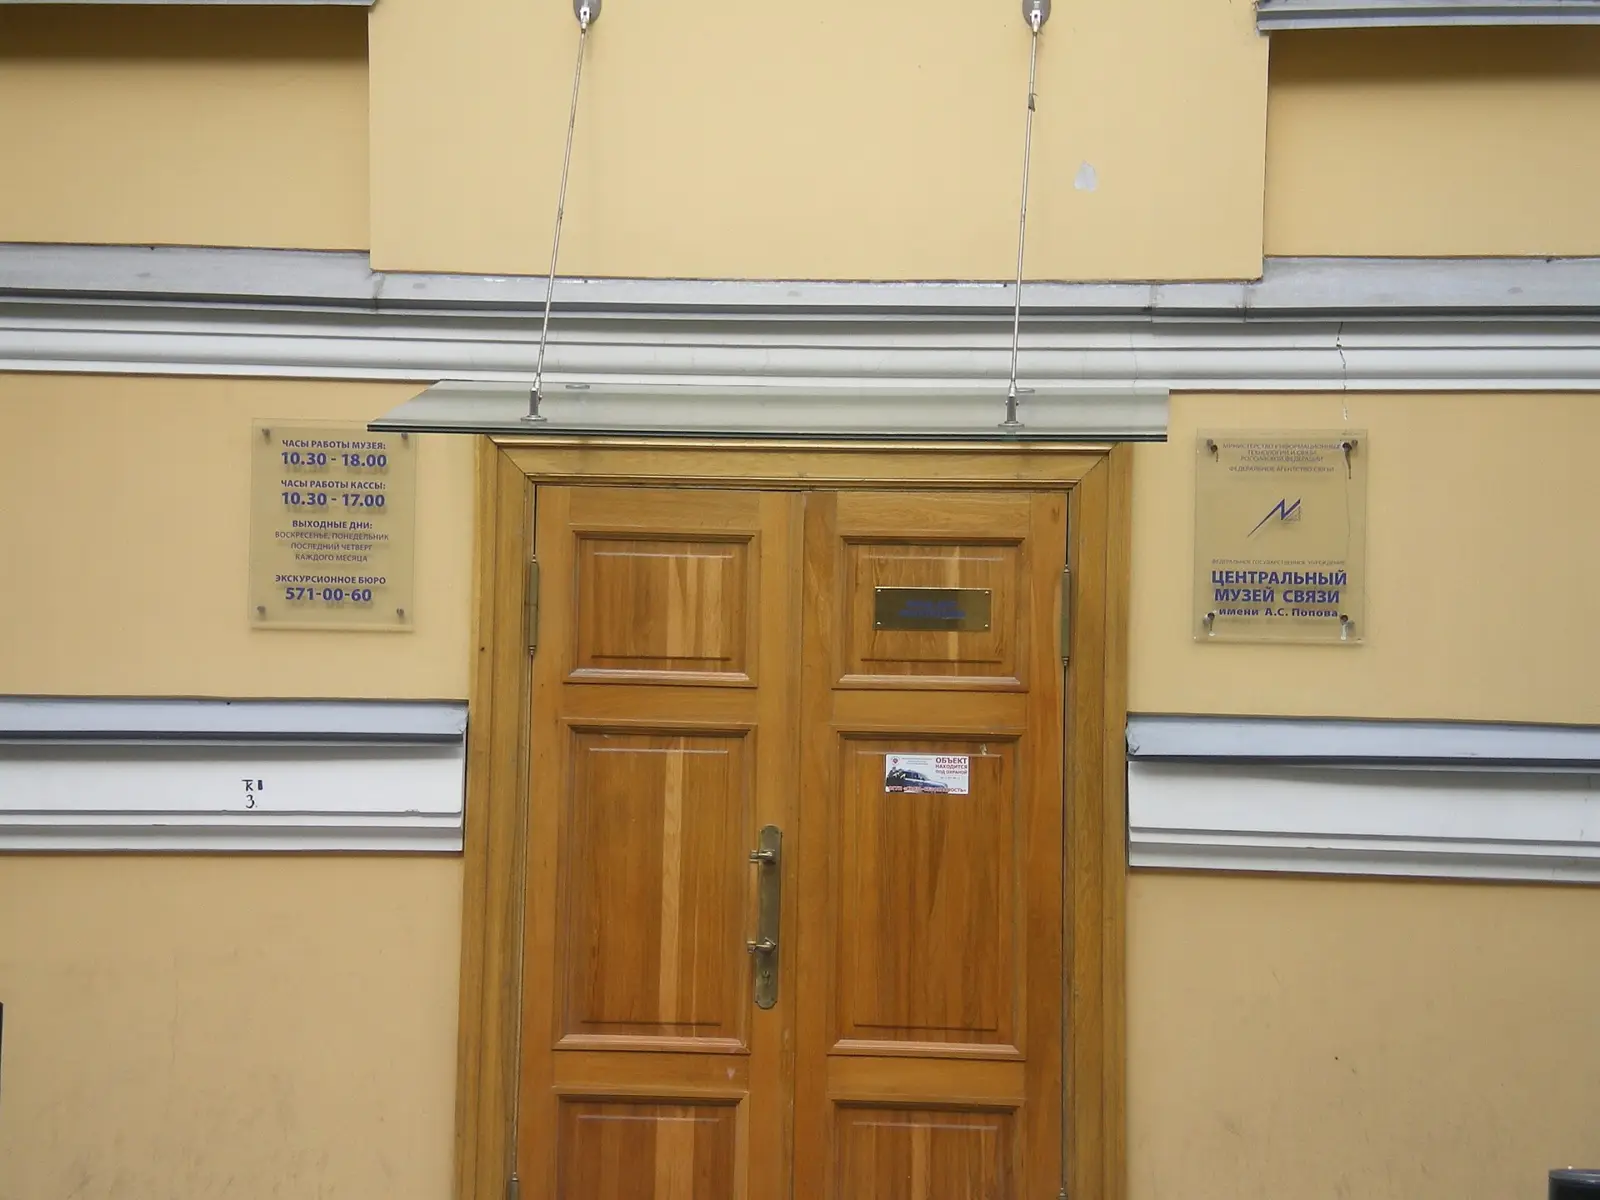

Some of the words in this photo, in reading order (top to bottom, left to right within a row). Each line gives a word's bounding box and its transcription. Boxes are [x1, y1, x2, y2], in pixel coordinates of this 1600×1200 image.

[282, 440, 309, 448] ЧАСЫ
[311, 440, 350, 449] РАБОТЫ
[352, 441, 386, 449] МУЗЕЯ:
[281, 452, 326, 466] 10.30
[342, 454, 387, 467] 18.00
[281, 480, 308, 488] ЧАСЫ
[310, 481, 348, 489] РАБОТЫ
[351, 482, 386, 490] КАССЫ:
[282, 492, 326, 505] 10.30
[342, 494, 385, 507] 17.00
[292, 520, 347, 529] ВЫХОДНЫЕ
[349, 522, 373, 531] ДНИ:
[276, 575, 356, 583] ЭКСКУРСИОННОЕ
[1212, 570, 1347, 586] ЦЕНТРАЛЬНЫЙ
[285, 587, 372, 601] 571-00-60
[1215, 587, 1274, 602] МУЗЕЙ
[1283, 590, 1339, 603] СВЯЗИ
[1219, 608, 1259, 616] имени
[1265, 608, 1288, 616] А.С.
[1292, 608, 1337, 617] Попова
